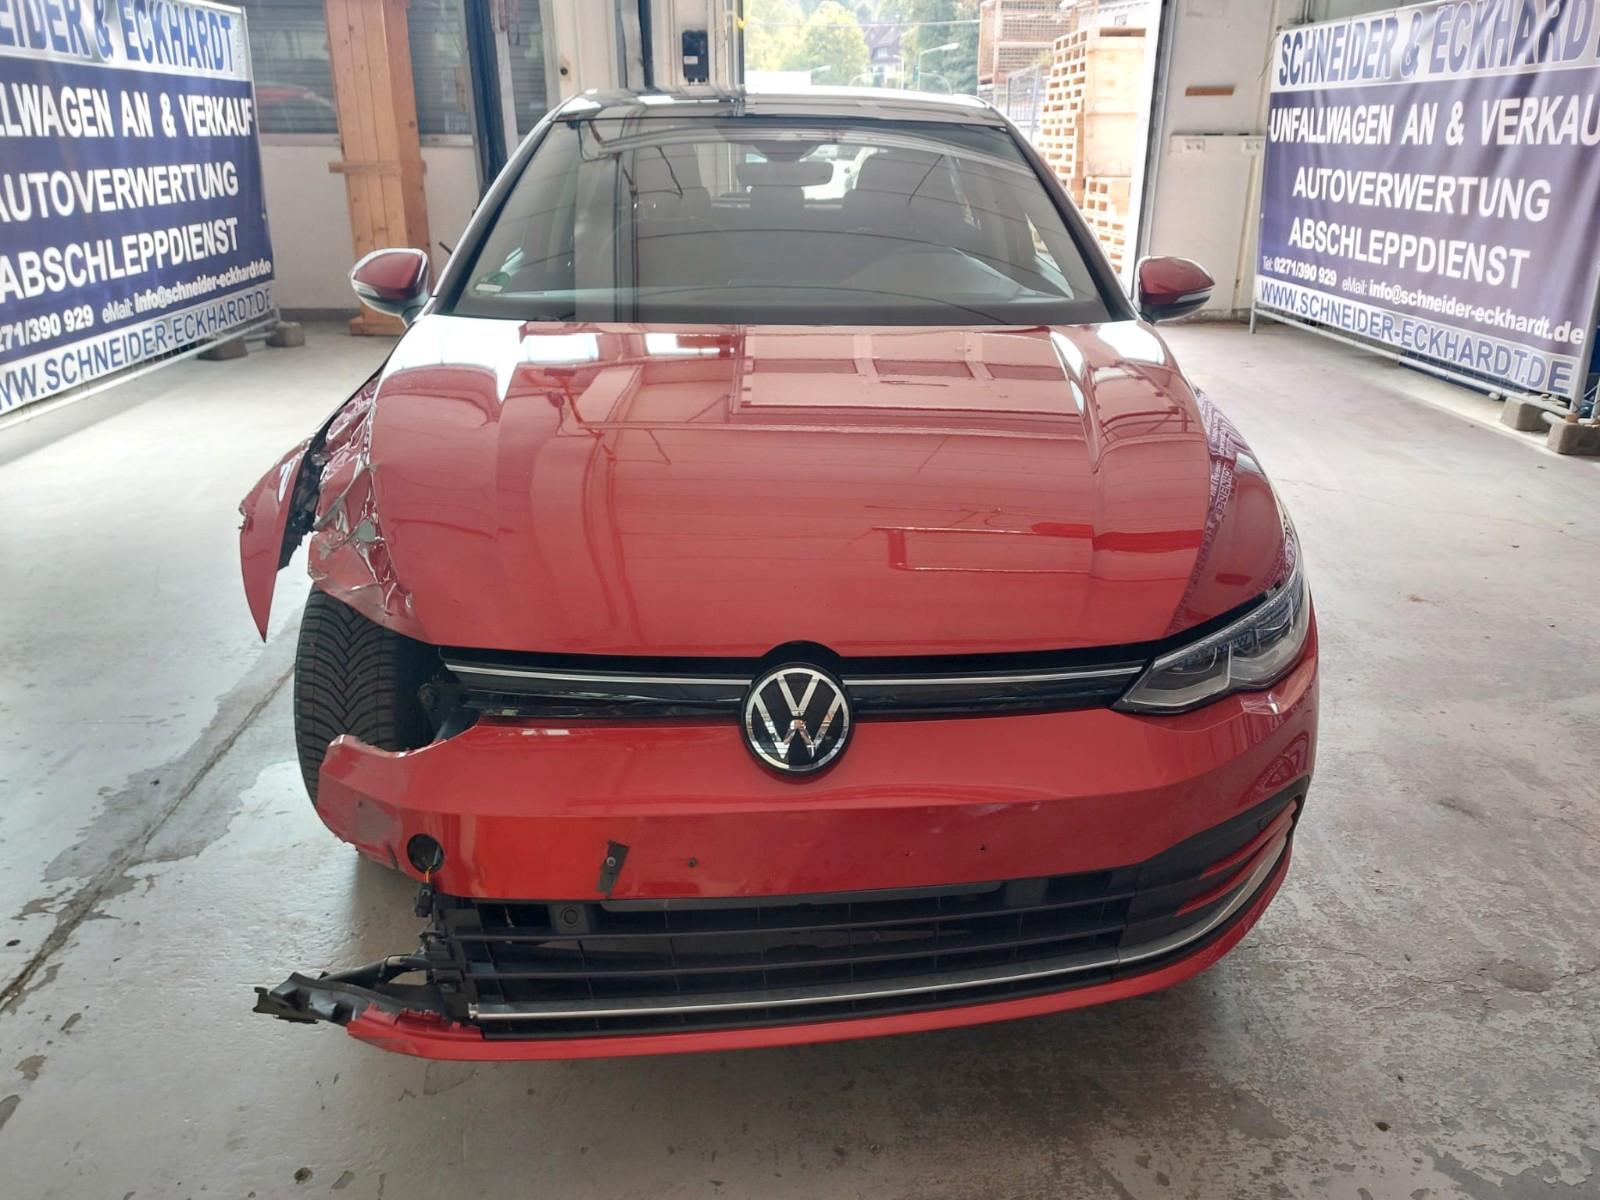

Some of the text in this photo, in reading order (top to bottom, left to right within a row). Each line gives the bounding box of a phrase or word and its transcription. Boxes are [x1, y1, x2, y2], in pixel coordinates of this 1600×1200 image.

[117, 0, 234, 73] ECKHARDT
[1279, 0, 1600, 87] SCHNEIDER & ECKHARD
[0, 82, 253, 138] LWAGEN AN & VERKAUF
[1269, 94, 1600, 146] UNFALLWAGEN AN & VERKAU
[0, 161, 239, 223] UTOVERWERTUNG
[1292, 166, 1552, 222] AUTOVERWERTUNG
[0, 217, 239, 304] ABSCHLEPPDIENST
[1288, 216, 1531, 289] ABSCHLEPPDIENST
[0, 312, 61, 351] 71/390
[63, 304, 95, 333] 929
[1261, 280, 1573, 394] WWW.SCHNEIDER-ECKHARDT.DE
[1273, 257, 1317, 281] 0271/390
[1318, 266, 1338, 287] 929
[1342, 276, 1368, 296] eMail:
[1369, 279, 1585, 345] info@schneider-eckhardt.de
